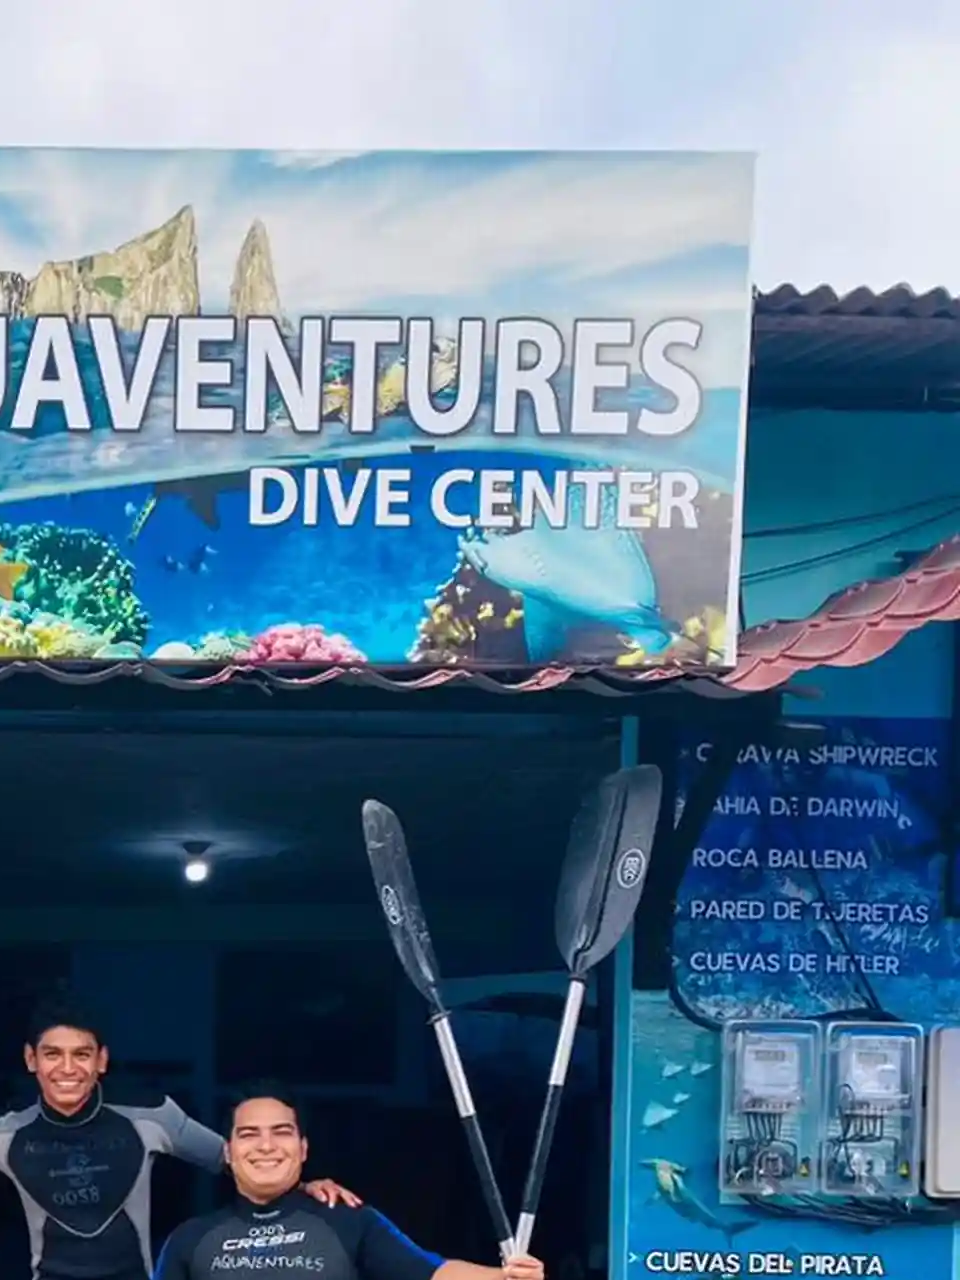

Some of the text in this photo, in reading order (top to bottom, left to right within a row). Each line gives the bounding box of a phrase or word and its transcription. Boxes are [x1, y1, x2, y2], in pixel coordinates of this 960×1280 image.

[248, 466, 700, 530] DIVE CENTER
[808, 744, 939, 767] SHIPWRECK
[712, 796, 761, 816] AHIA
[806, 797, 900, 819] DARWIN
[691, 848, 869, 870] ROCA BALLENA
[690, 899, 929, 924] PARED DE TJERETAS
[690, 952, 781, 973] CUEVAS
[789, 953, 818, 973] DE
[222, 1231, 306, 1250] CRESSI
[210, 1253, 325, 1272] AQUAVENTURES
[645, 1251, 885, 1276] CUEVAS DEL PIRATA
